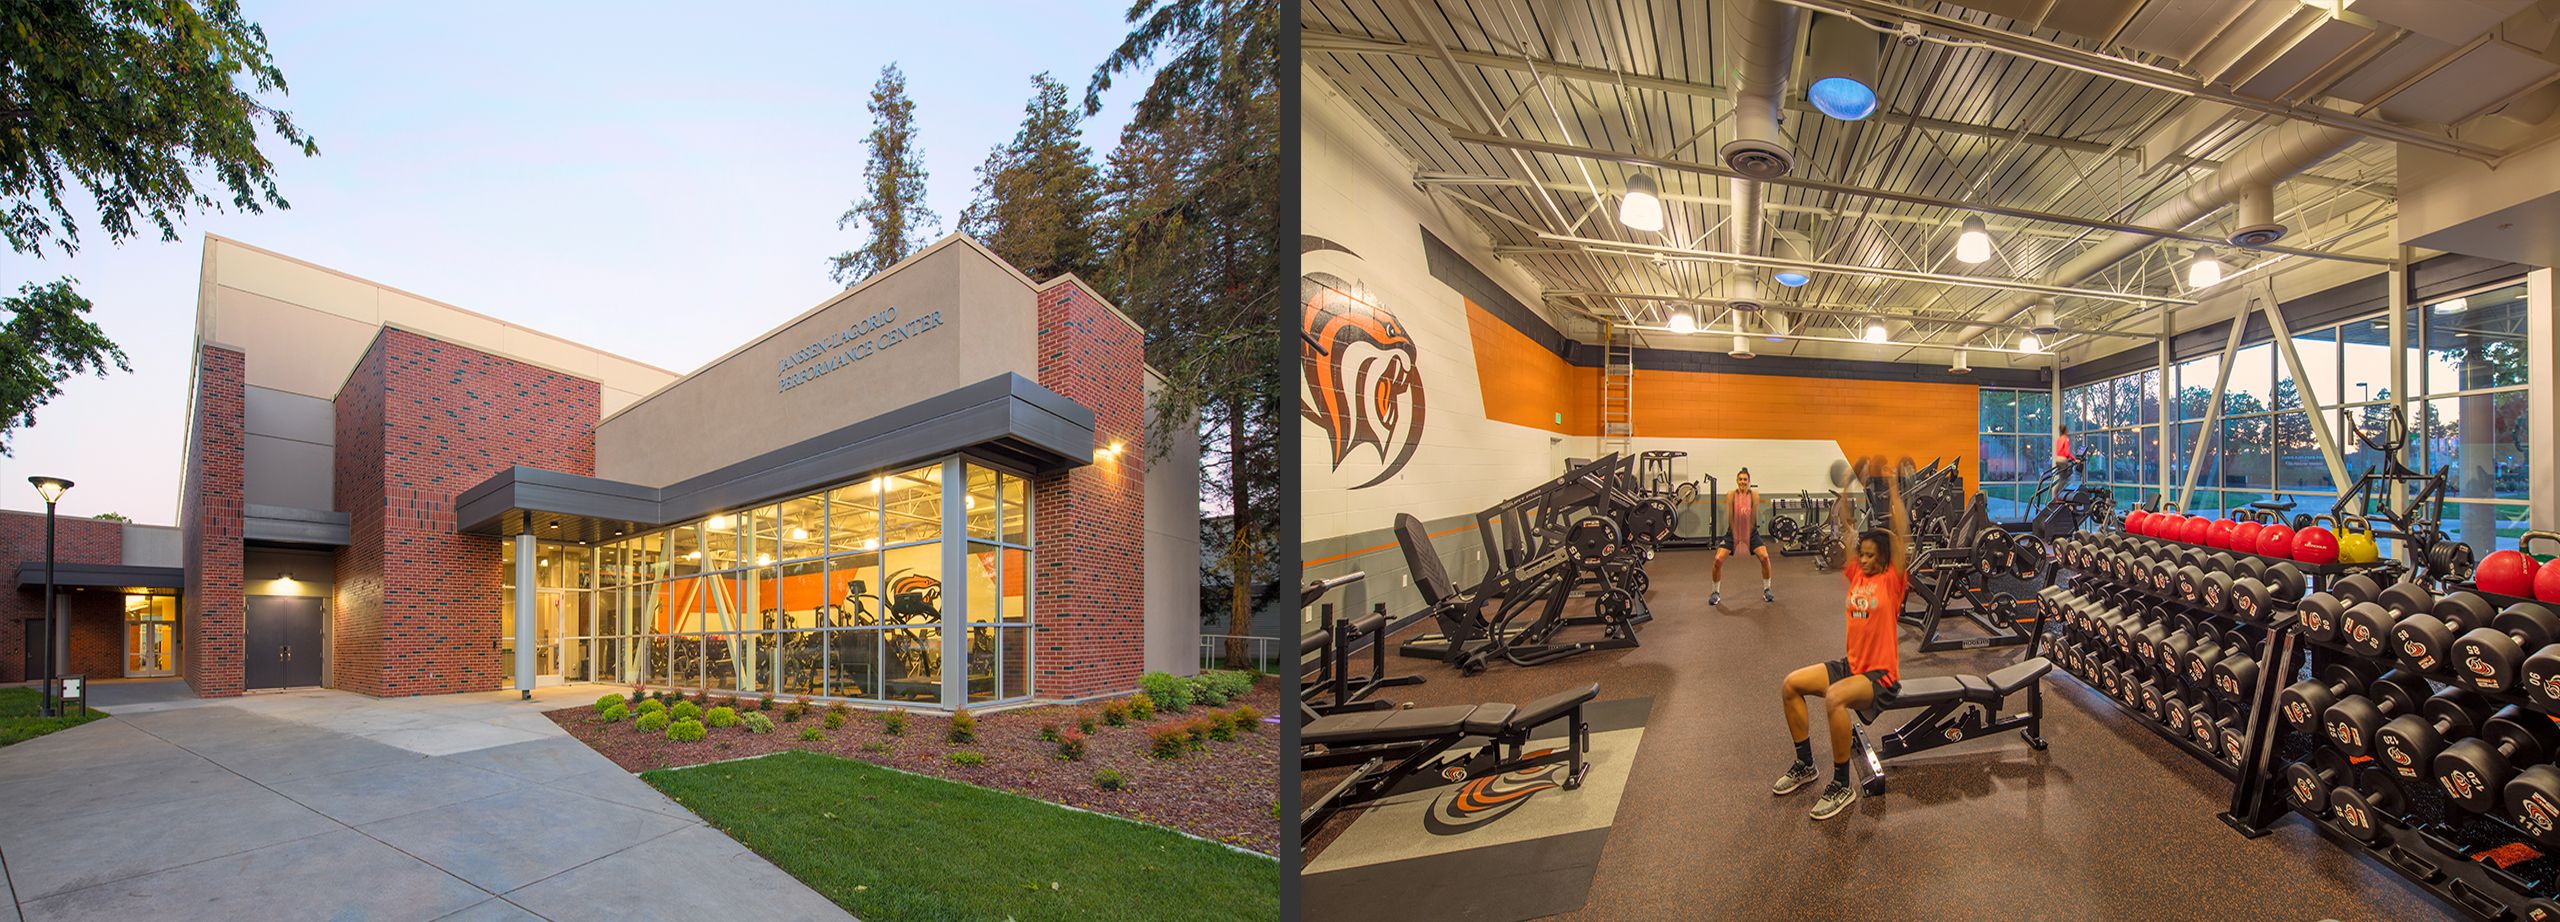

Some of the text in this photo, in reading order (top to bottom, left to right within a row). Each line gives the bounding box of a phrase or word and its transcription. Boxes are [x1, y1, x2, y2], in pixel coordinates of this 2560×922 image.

[777, 306, 897, 377] JANSSEN-LAGORIO
[778, 310, 944, 393] PERFORMANCE CENTER
[1650, 502, 1665, 511] 45
[1987, 531, 2000, 541] 45
[1568, 545, 1582, 561] 45
[2397, 629, 2410, 641] 85
[2465, 645, 2481, 655] 85
[2528, 671, 2541, 687] 90
[2327, 720, 2338, 739] 125
[2382, 735, 2400, 745] 120
[2465, 771, 2486, 793] 120
[2519, 815, 2542, 838] 115
